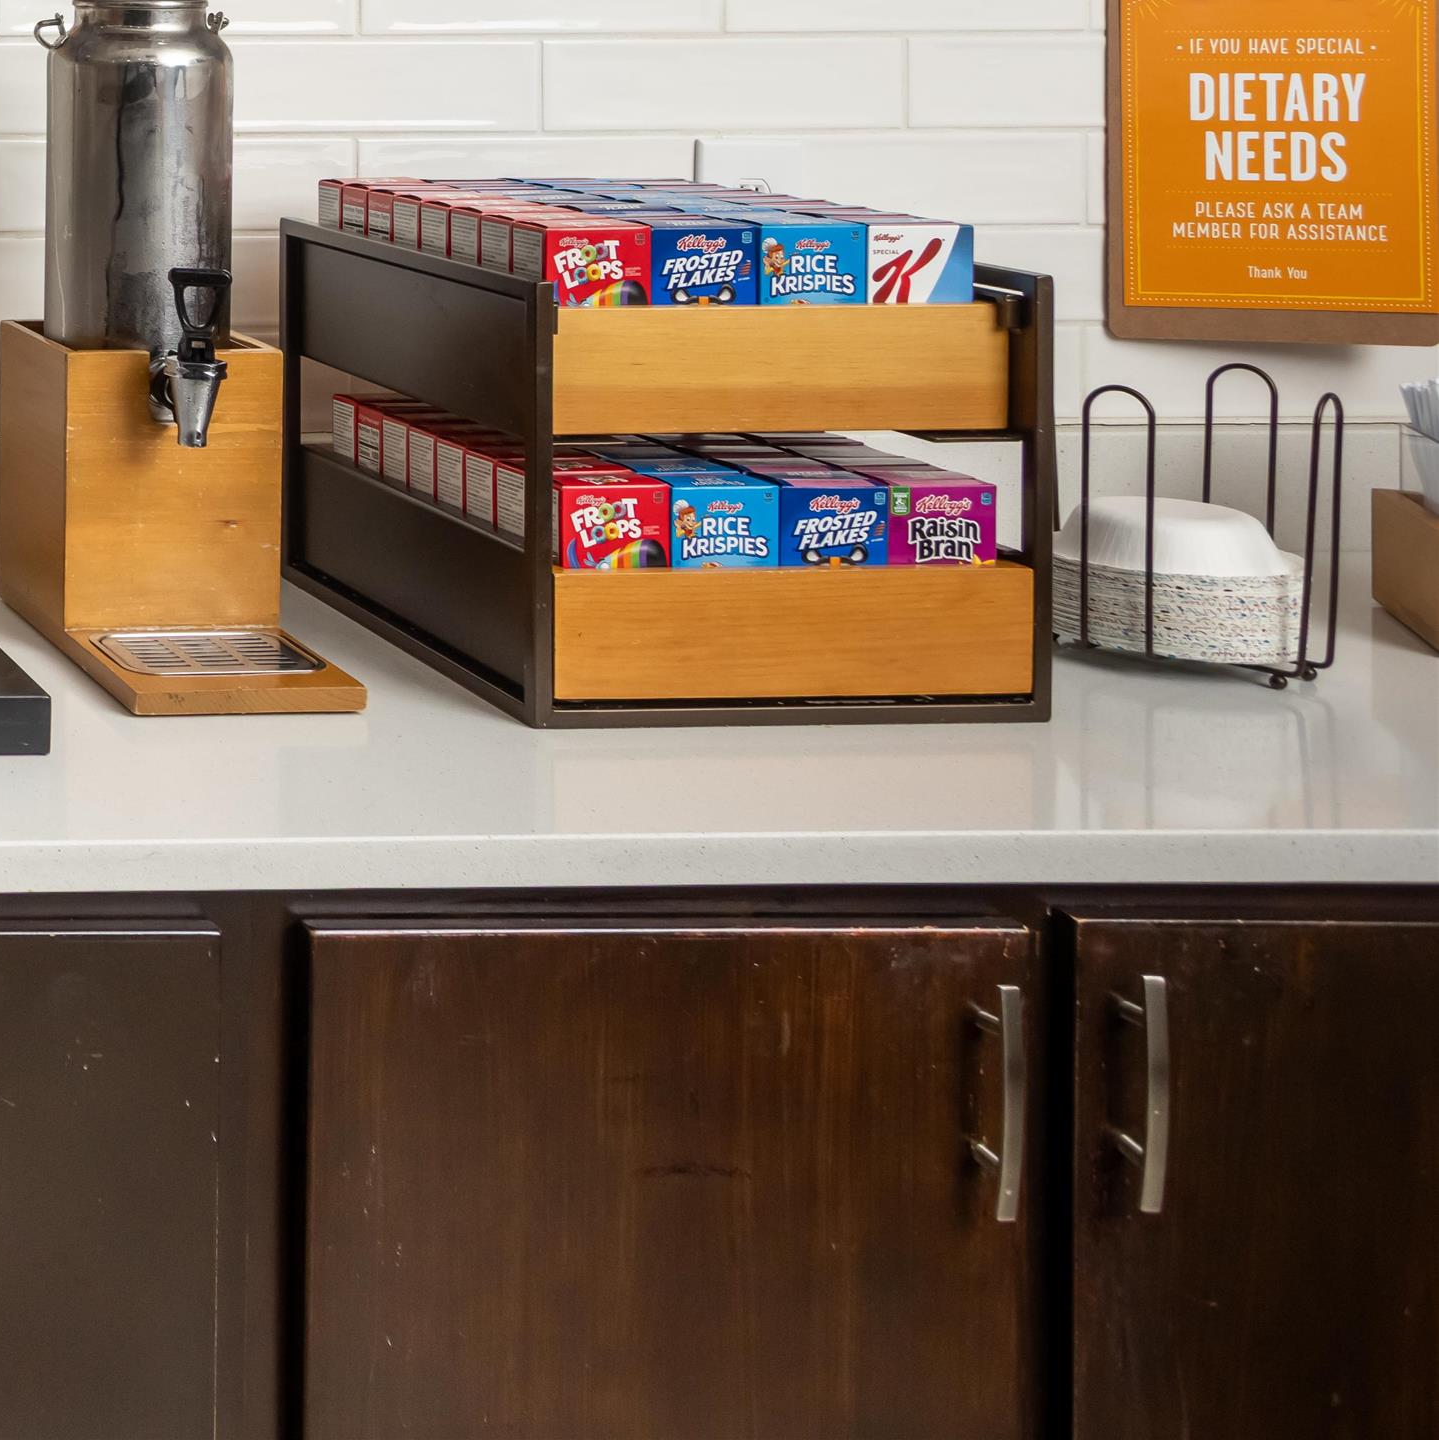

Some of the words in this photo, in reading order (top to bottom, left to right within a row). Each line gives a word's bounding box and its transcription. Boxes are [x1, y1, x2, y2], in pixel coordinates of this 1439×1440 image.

[1189, 38, 1204, 55] IF
[1209, 38, 1241, 55] YOU
[1248, 38, 1289, 55] HAVE
[1296, 38, 1364, 55] SPECIAL
[1189, 72, 1366, 122] DIETARY
[1205, 130, 1348, 183] NEEDS
[1195, 201, 1255, 219] PLEASE
[1262, 202, 1294, 219] ASK
[1300, 203, 1312, 219] A
[1317, 203, 1363, 220] TEAM
[1172, 222, 1241, 239] MEMBER
[1250, 224, 1279, 240] FOR
[1287, 224, 1388, 242] ASSISTANCE
[677, 235, 727, 253] Kellogg's
[553, 239, 620, 274] FROOT
[662, 250, 744, 276] FROSTED
[791, 254, 837, 273] RICE
[562, 261, 623, 289] LOOPS
[667, 266, 736, 290] FLAKES
[872, 238, 943, 304] K
[1247, 265, 1282, 280] Thank
[1287, 266, 1307, 280] You
[771, 275, 855, 295] KRISPIES
[570, 498, 638, 533] FROOT
[809, 495, 861, 515] Kellogg's
[916, 495, 972, 516] Kellogg's
[579, 519, 642, 548] LOOPS
[703, 517, 750, 535] RICE
[794, 510, 877, 536] FROSTED
[908, 517, 981, 544] Raisin
[682, 537, 770, 559] KRISPIES
[798, 527, 870, 550] FLAKES
[915, 539, 974, 563] Bran
